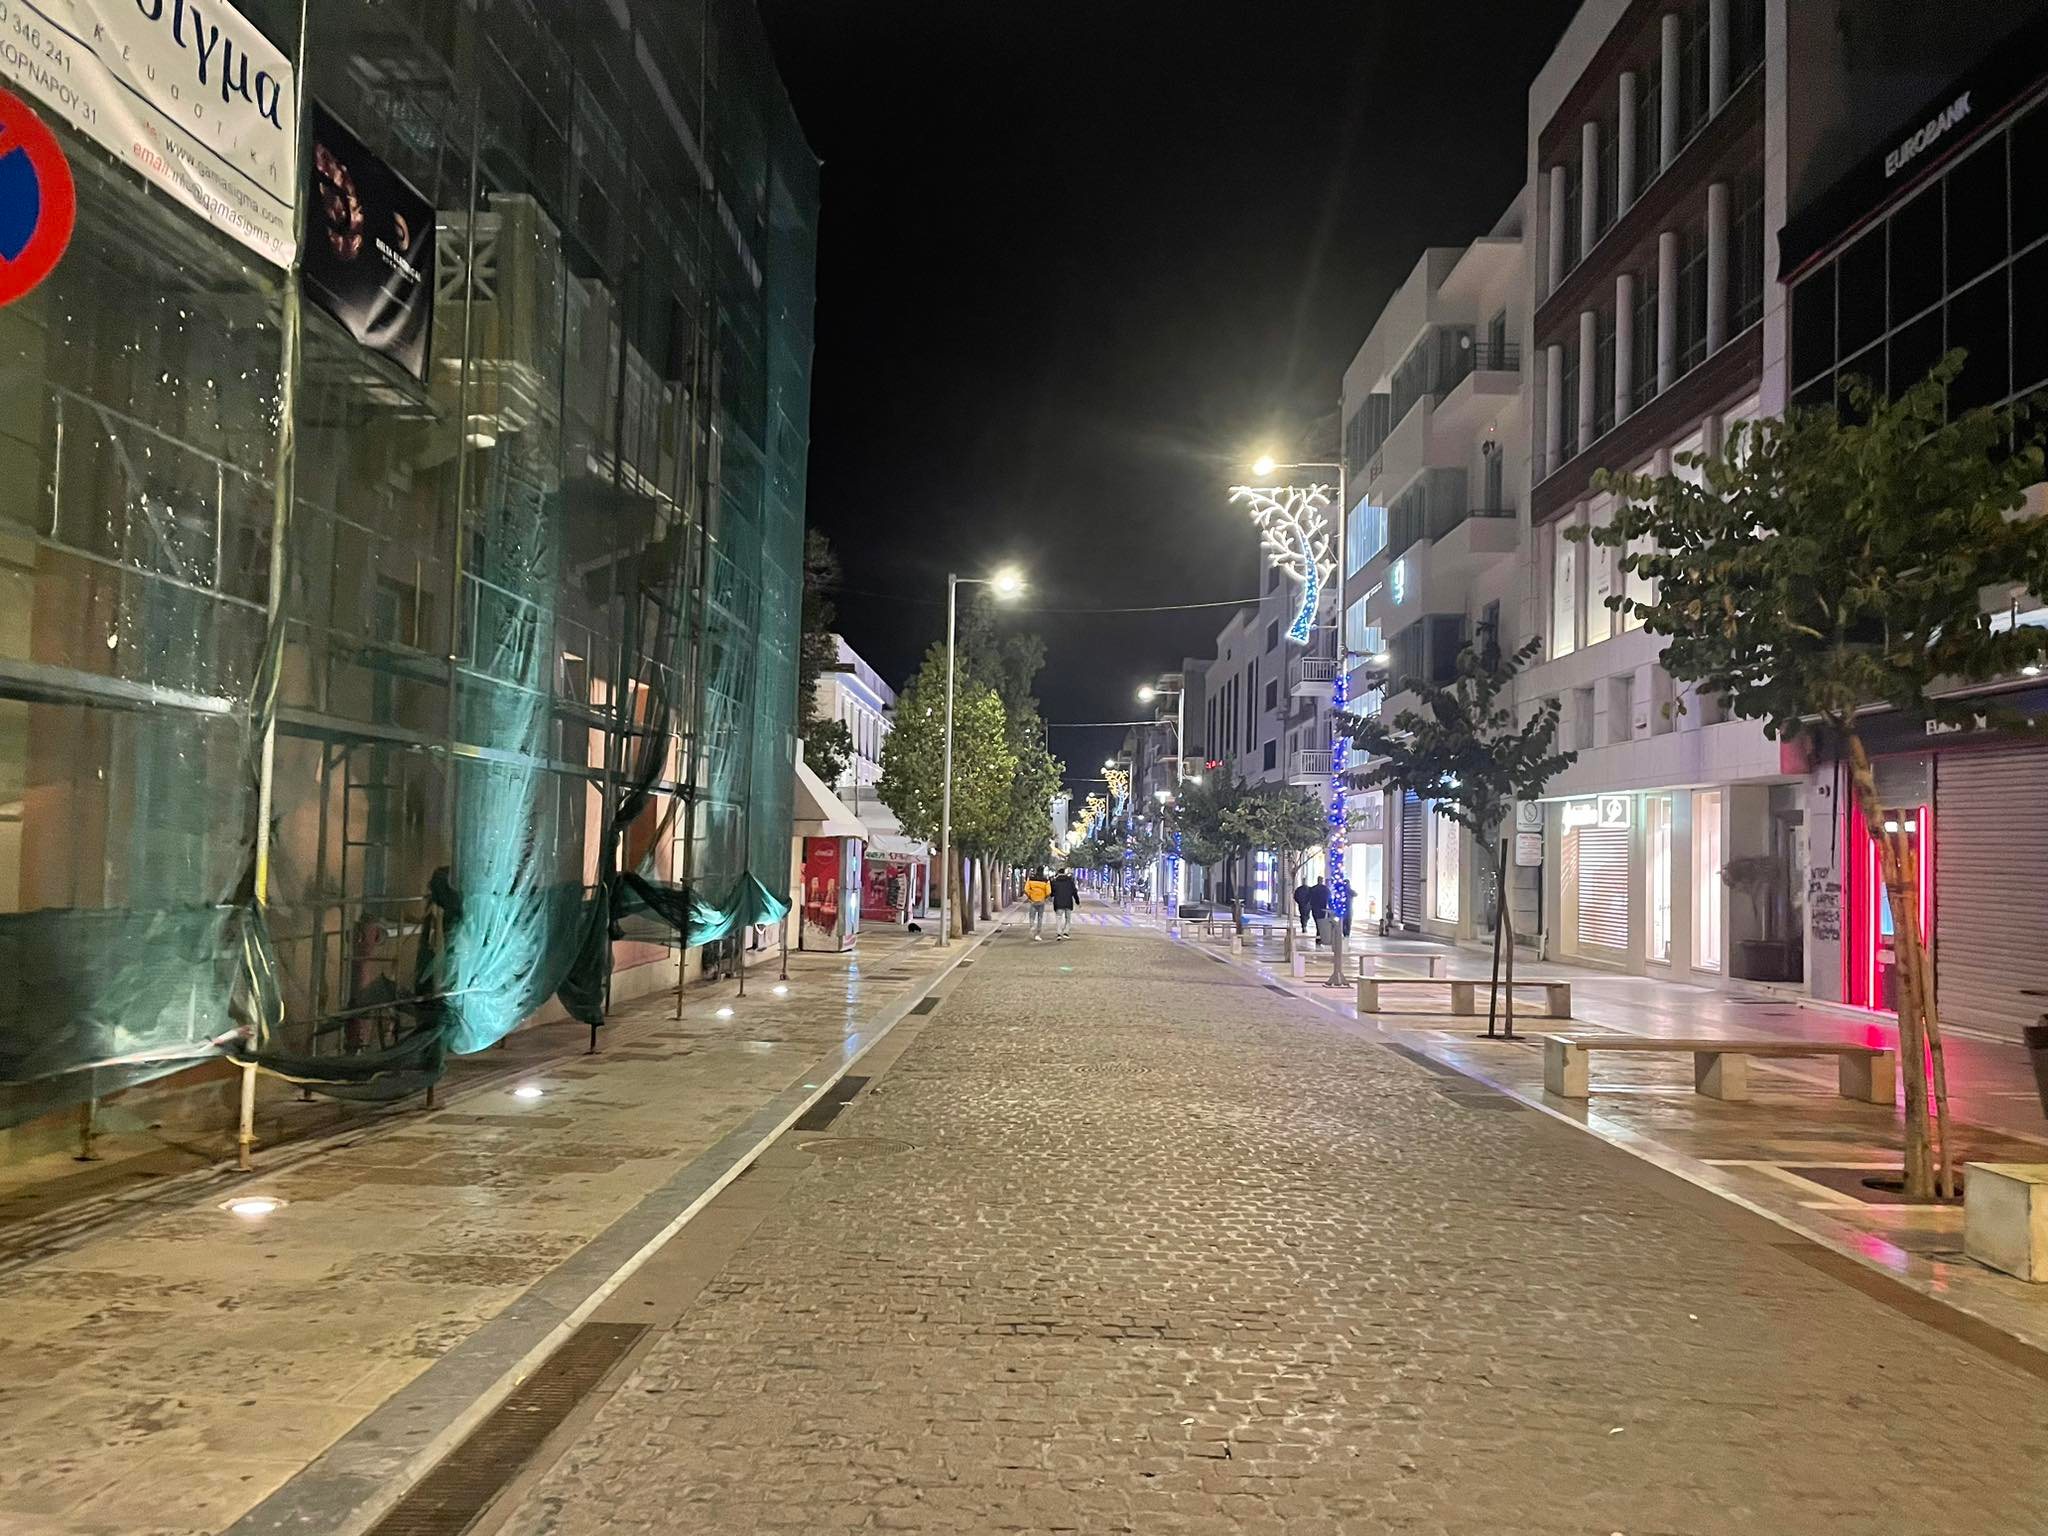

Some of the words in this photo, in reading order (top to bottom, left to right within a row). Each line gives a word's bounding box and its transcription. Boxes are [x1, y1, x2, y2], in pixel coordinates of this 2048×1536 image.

[13, 13, 41, 50] 346
[45, 40, 71, 74] 241
[82, 101, 97, 125] 31
[1884, 90, 1972, 178] EUROBANK
